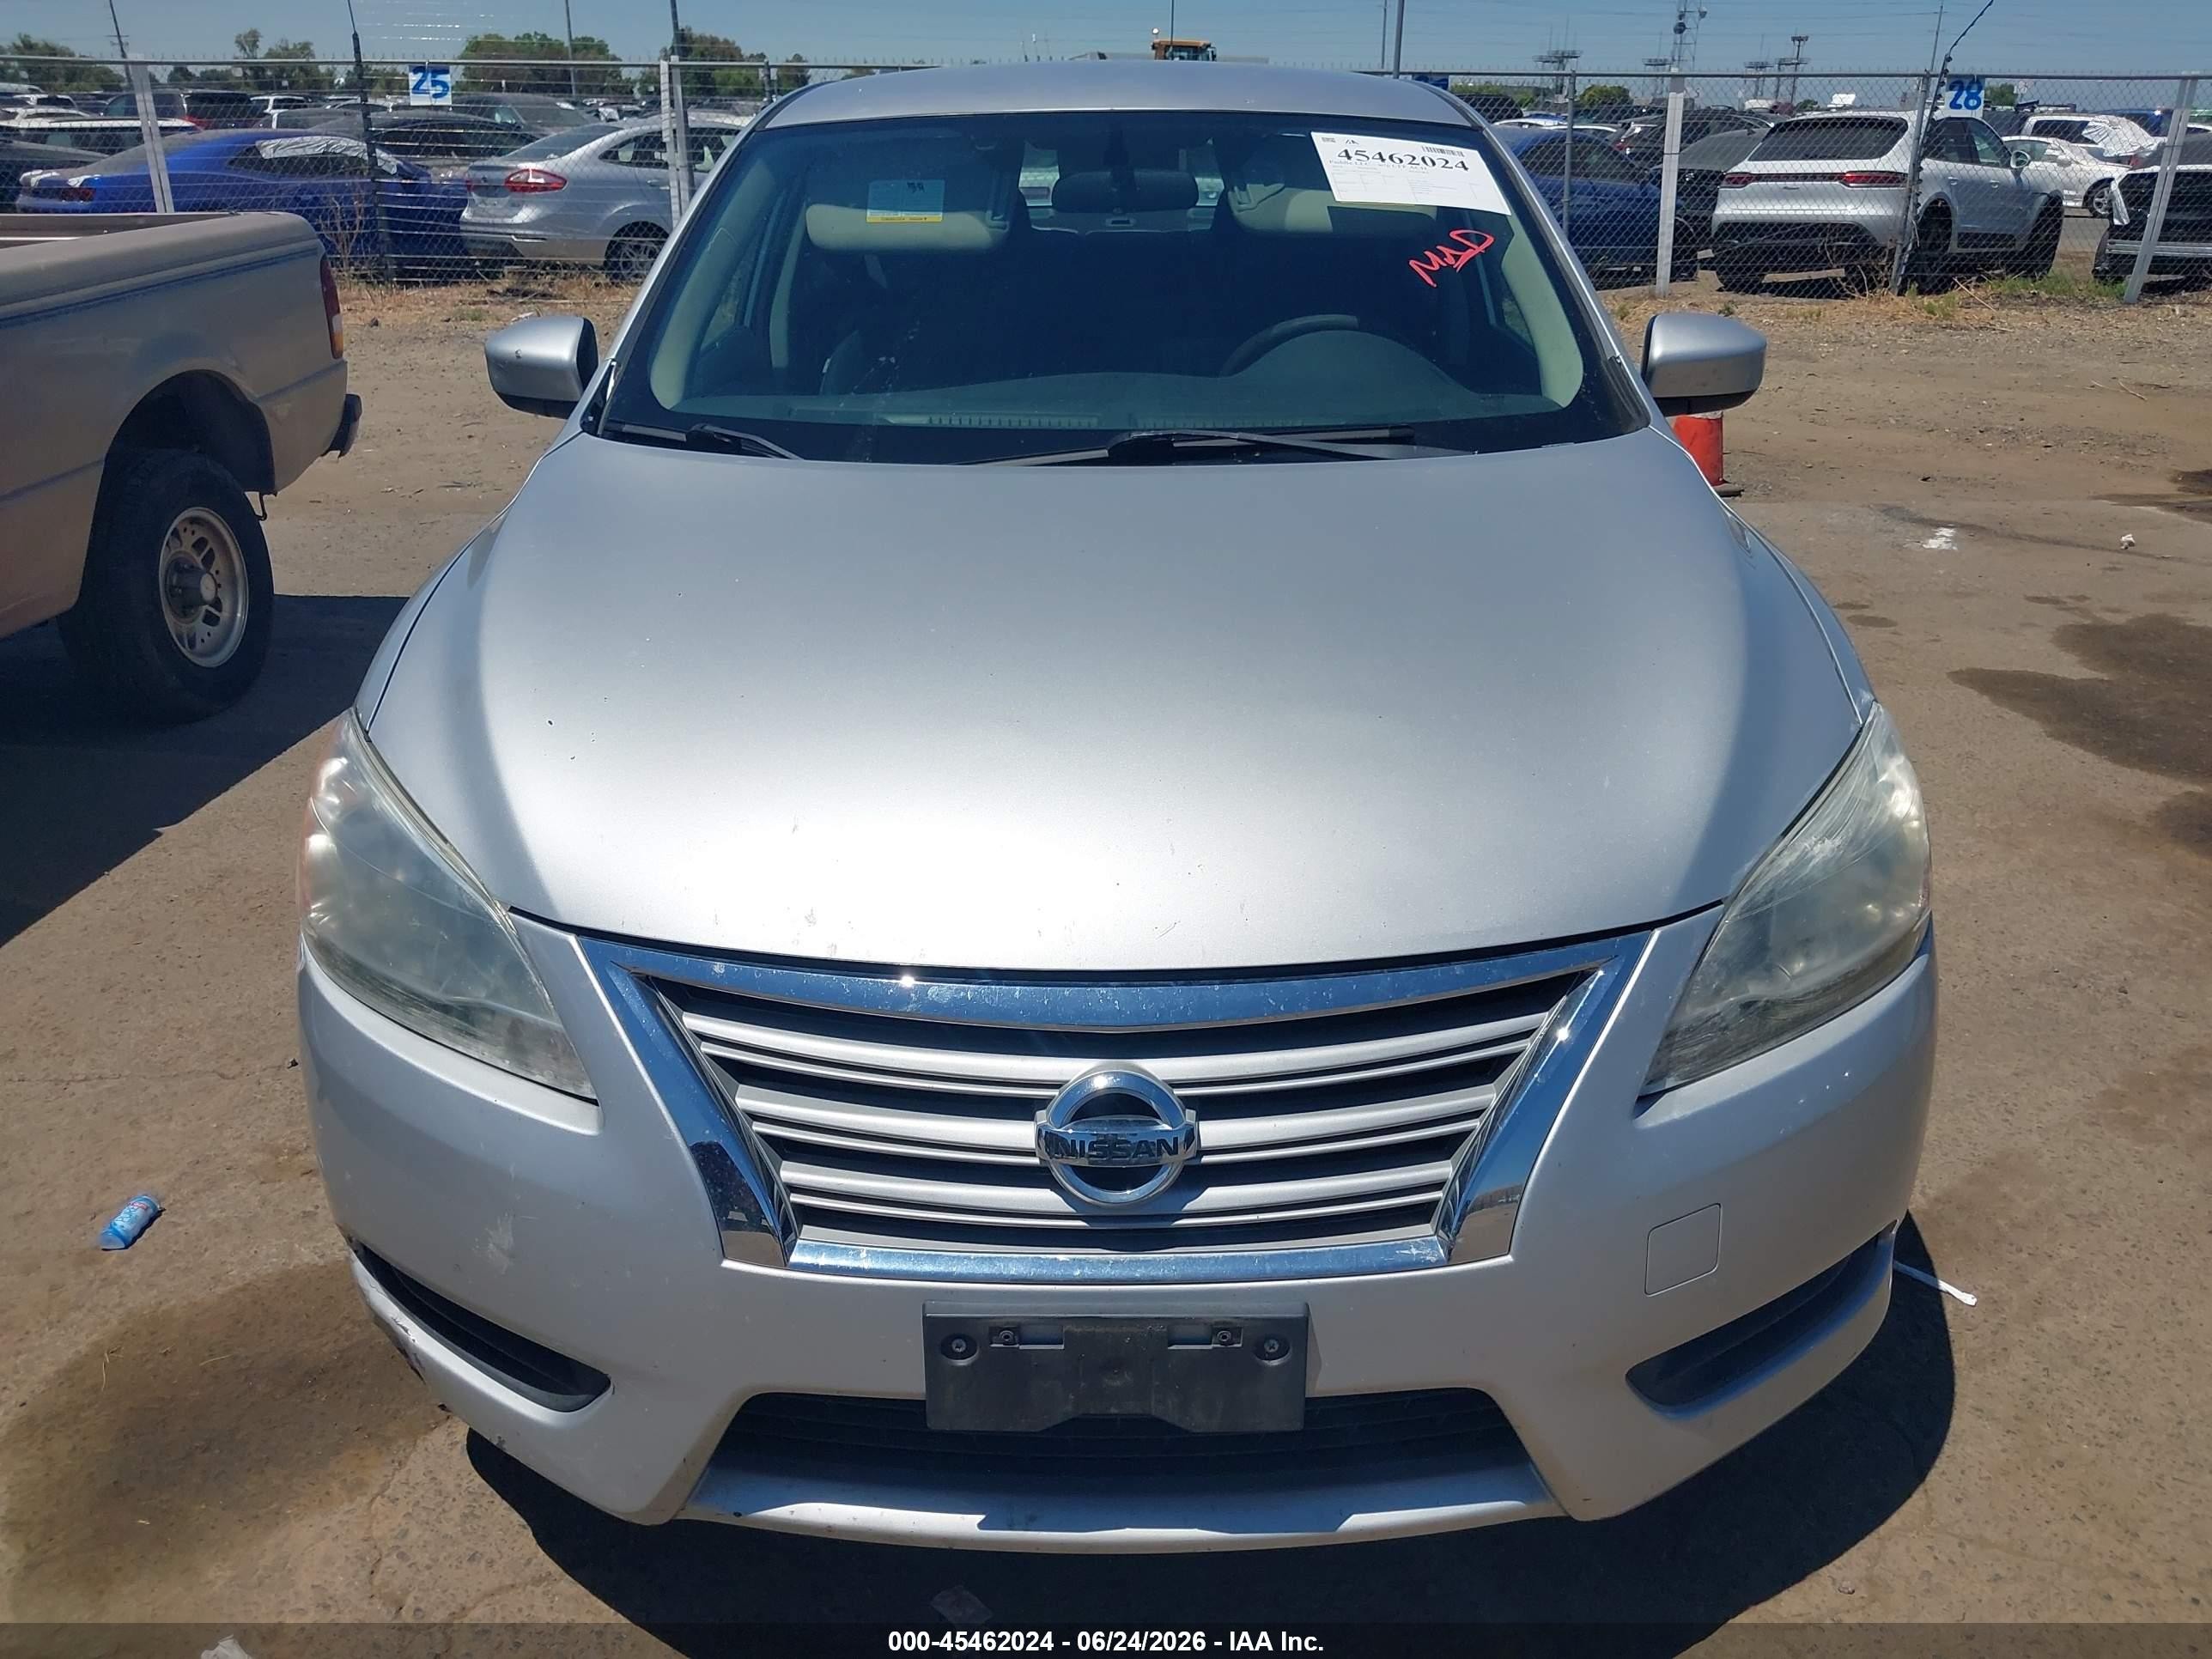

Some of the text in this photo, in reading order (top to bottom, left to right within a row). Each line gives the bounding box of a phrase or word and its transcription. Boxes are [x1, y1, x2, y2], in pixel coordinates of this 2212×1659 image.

[412, 66, 450, 99] 25
[1948, 79, 1983, 111] 28
[1338, 149, 1469, 172] 45462024
[1045, 1130, 1179, 1159] NISSAN
